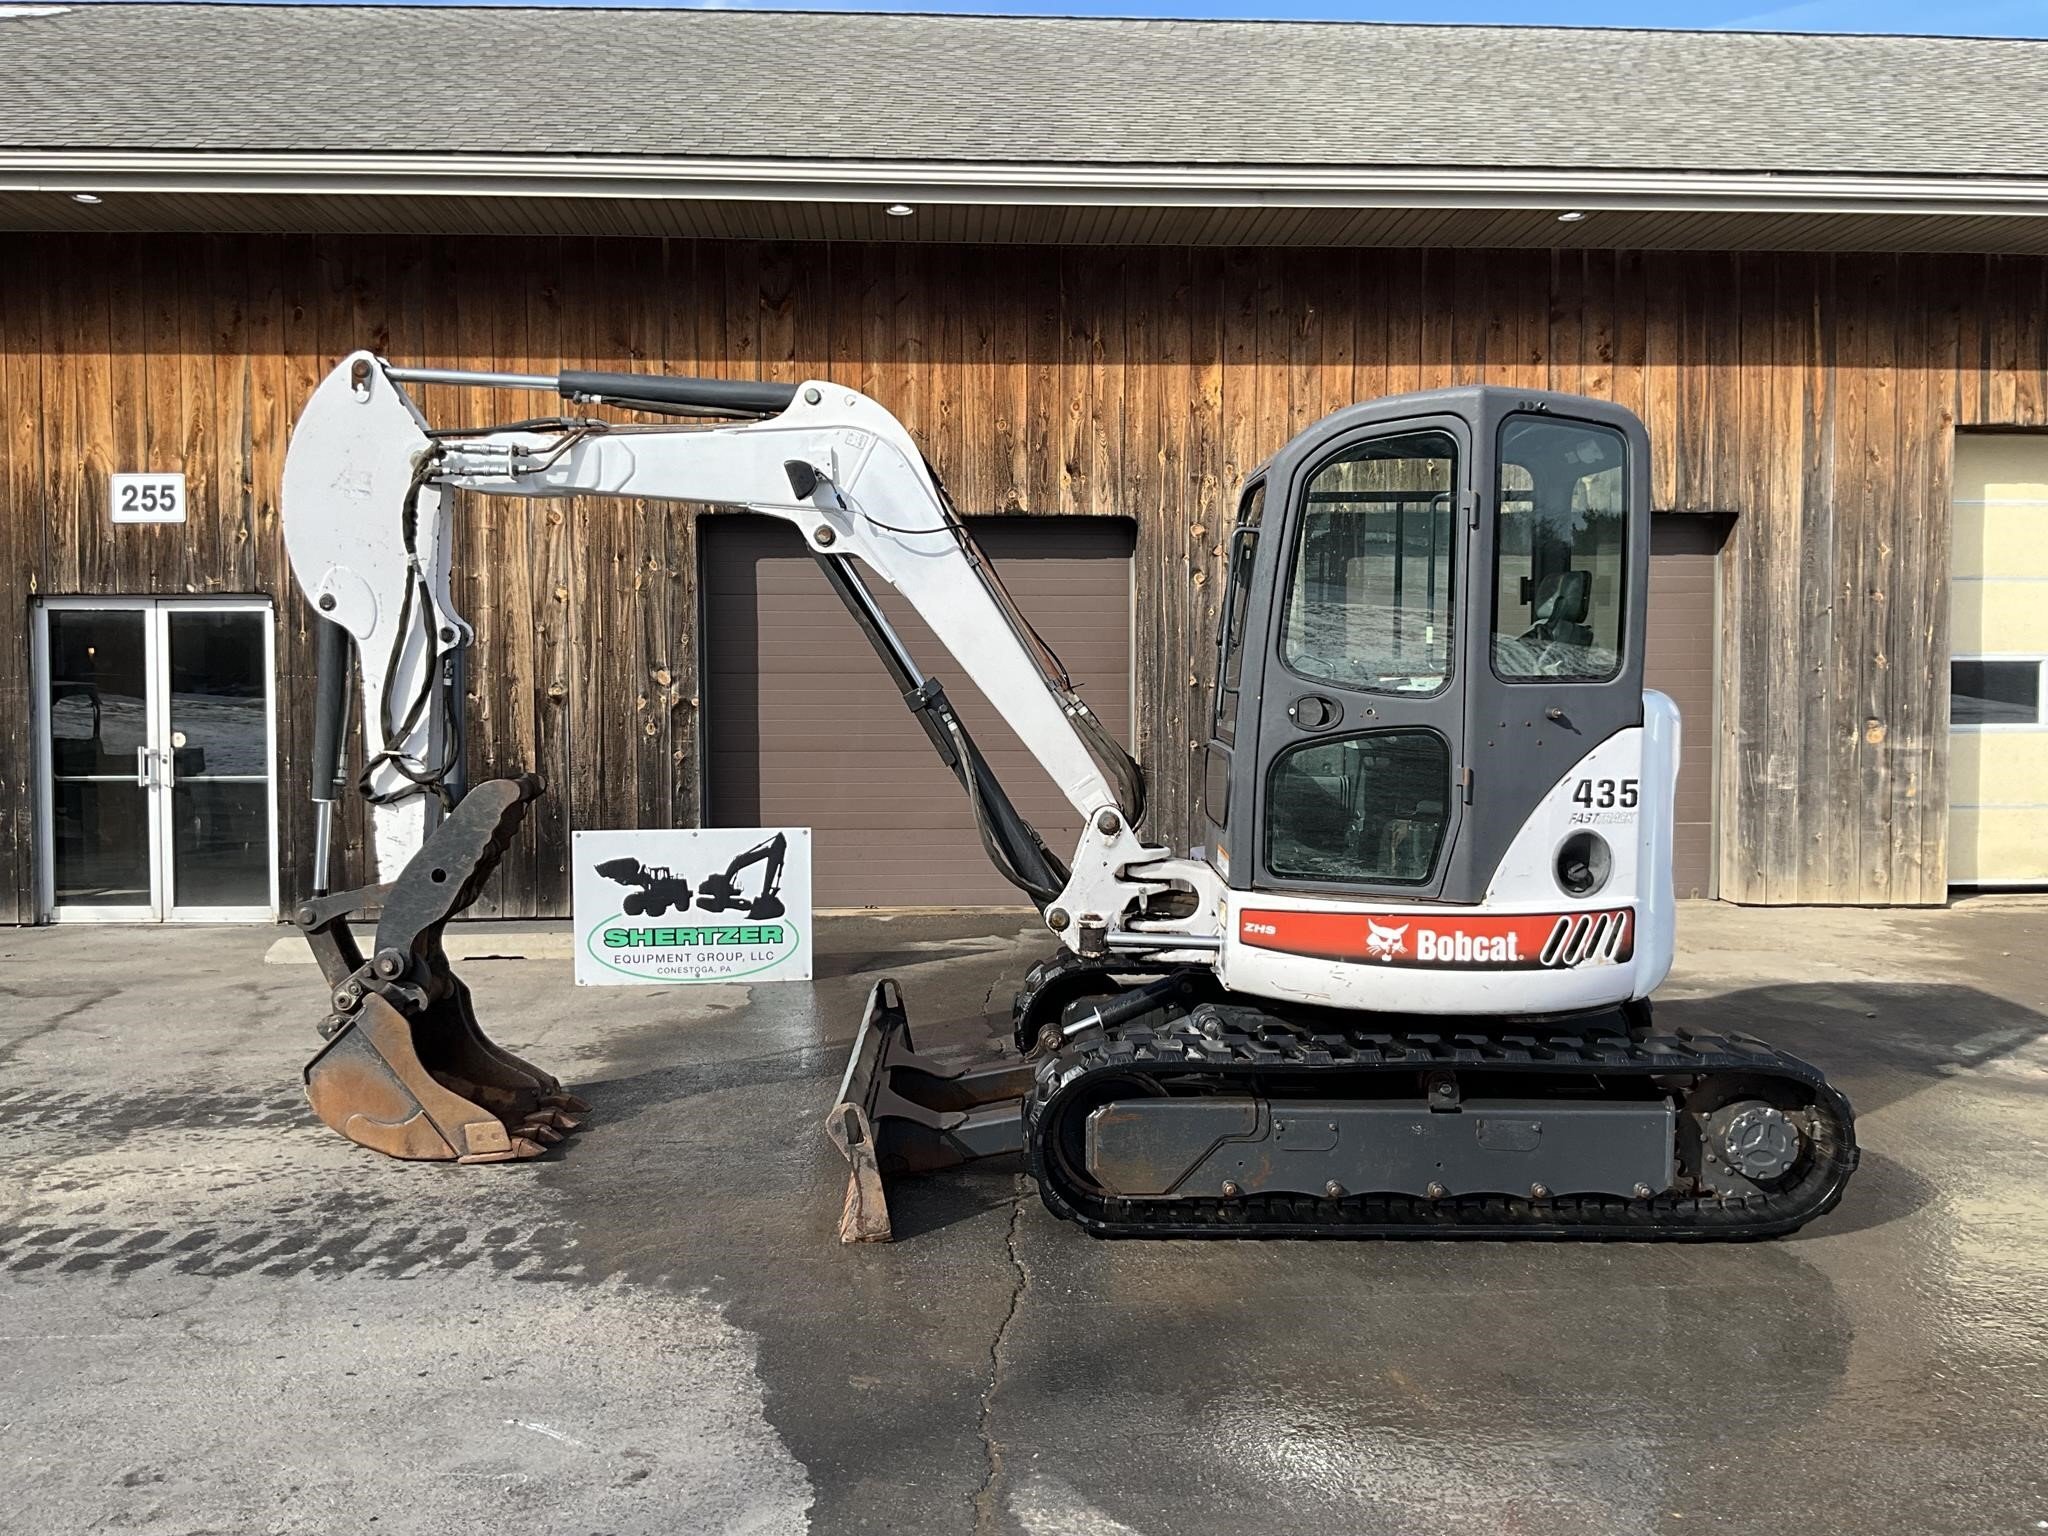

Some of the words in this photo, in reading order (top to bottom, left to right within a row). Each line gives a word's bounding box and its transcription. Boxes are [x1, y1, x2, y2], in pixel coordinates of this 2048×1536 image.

[121, 484, 176, 512] 255
[1572, 779, 1638, 808] 435
[604, 925, 783, 948] SHERTZER
[1243, 922, 1276, 934] ZHS
[1417, 929, 1518, 961] Bobcat
[614, 953, 691, 964] EQUIPMENT
[697, 952, 745, 962] GROUP,
[750, 951, 774, 961] LLC
[657, 966, 717, 974] CONESTOGA,
